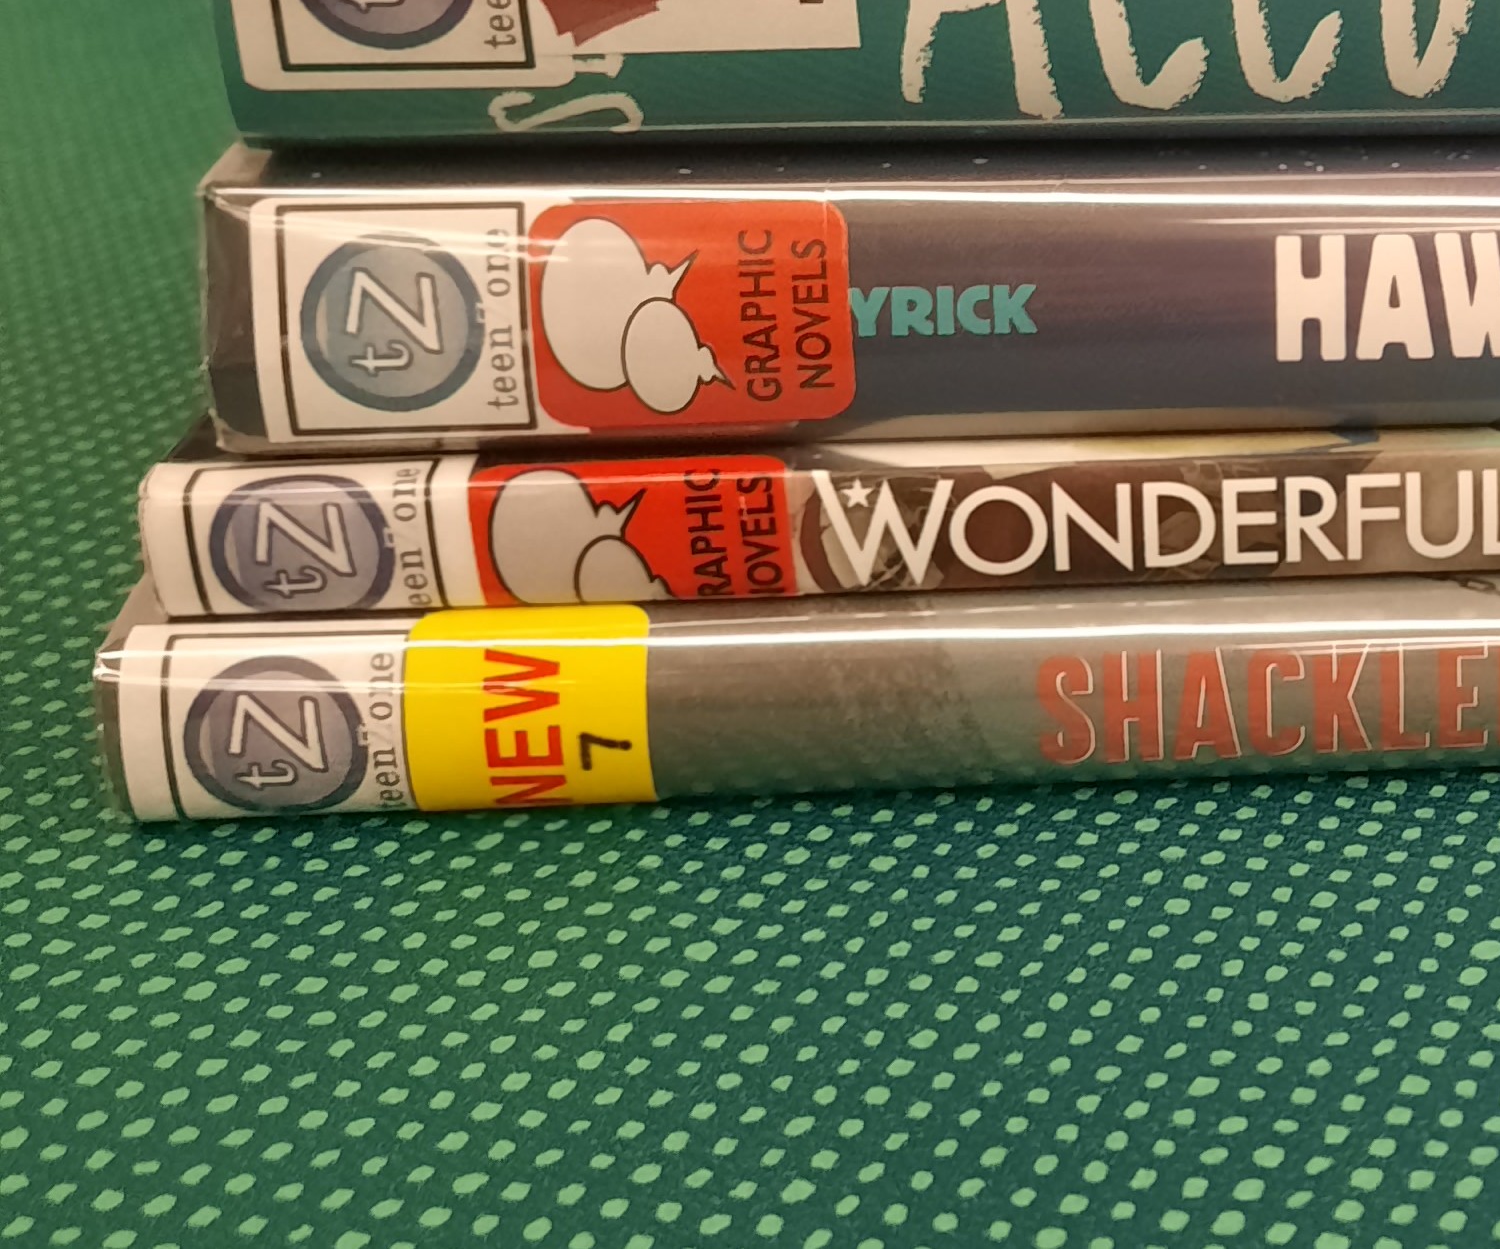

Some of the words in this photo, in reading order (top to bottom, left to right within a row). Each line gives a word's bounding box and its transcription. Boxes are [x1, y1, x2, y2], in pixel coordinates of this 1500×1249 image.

[738, 228, 782, 403] GRAPHIC
[791, 237, 836, 390] NOVELS
[847, 283, 1039, 338] YRICK
[683, 467, 735, 597] RAPHIC
[735, 475, 786, 595] OVELS
[482, 647, 573, 807] NEW
[578, 731, 633, 772] 7
